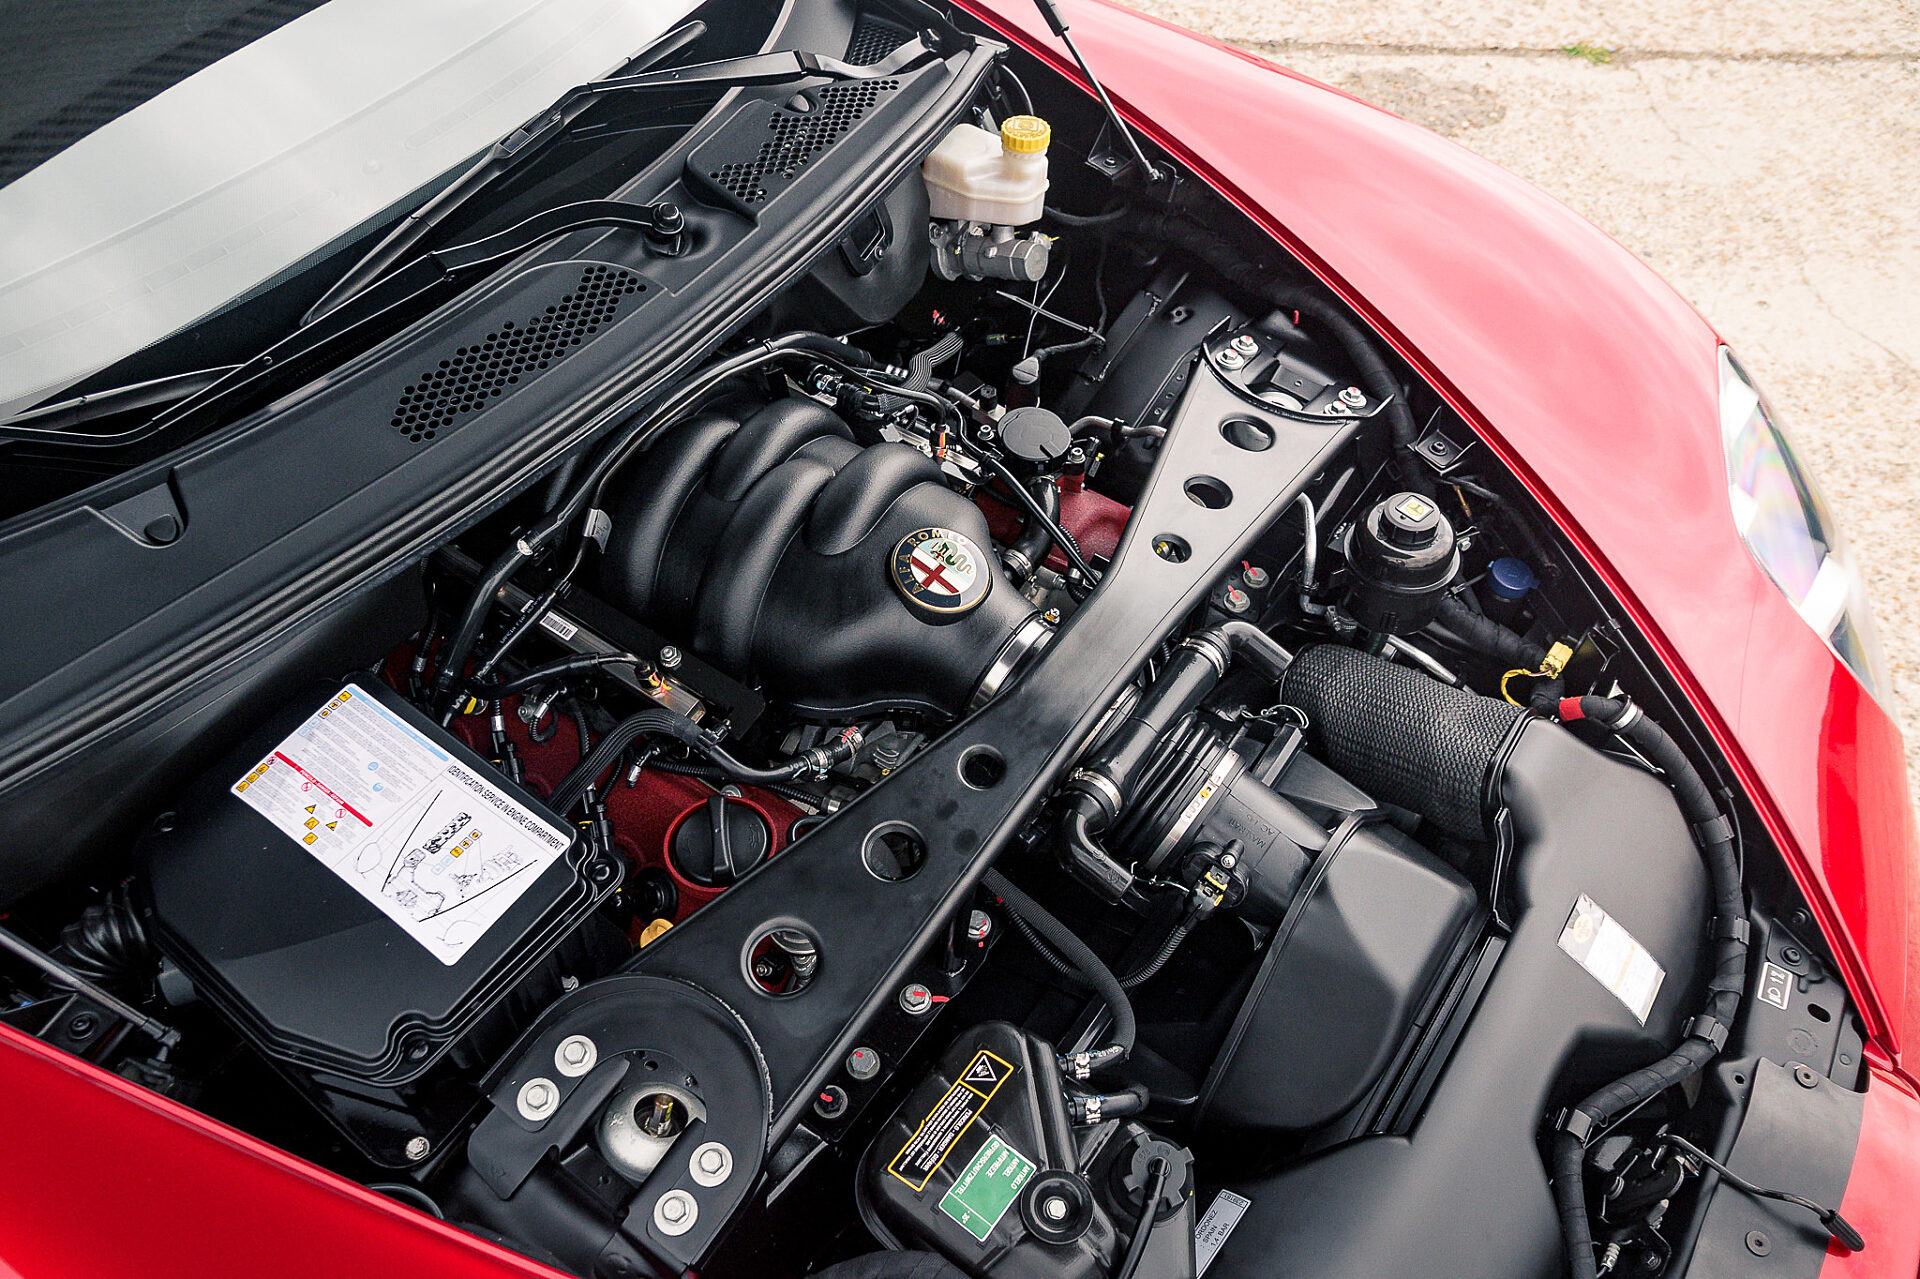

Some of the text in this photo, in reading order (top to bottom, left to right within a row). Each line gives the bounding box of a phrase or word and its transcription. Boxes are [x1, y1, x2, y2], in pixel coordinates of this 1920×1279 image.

[899, 529, 968, 594] ALFA ROMEO
[446, 764, 564, 851] IDENTIFICATION SERVICE IN ENGINE COMPARTMENT
[954, 1139, 1000, 1196] GEFRIERSCHUTZMITTEL
[984, 1148, 1010, 1178] ANTIFREEZE
[1001, 1156, 1020, 1178] ANTIGEL
[1009, 1164, 1031, 1190] ANTIGELO
[1195, 1209, 1218, 1239] ORDONEZ
[1203, 1225, 1217, 1243] SPAIN
[1218, 1223, 1230, 1237] BAR
